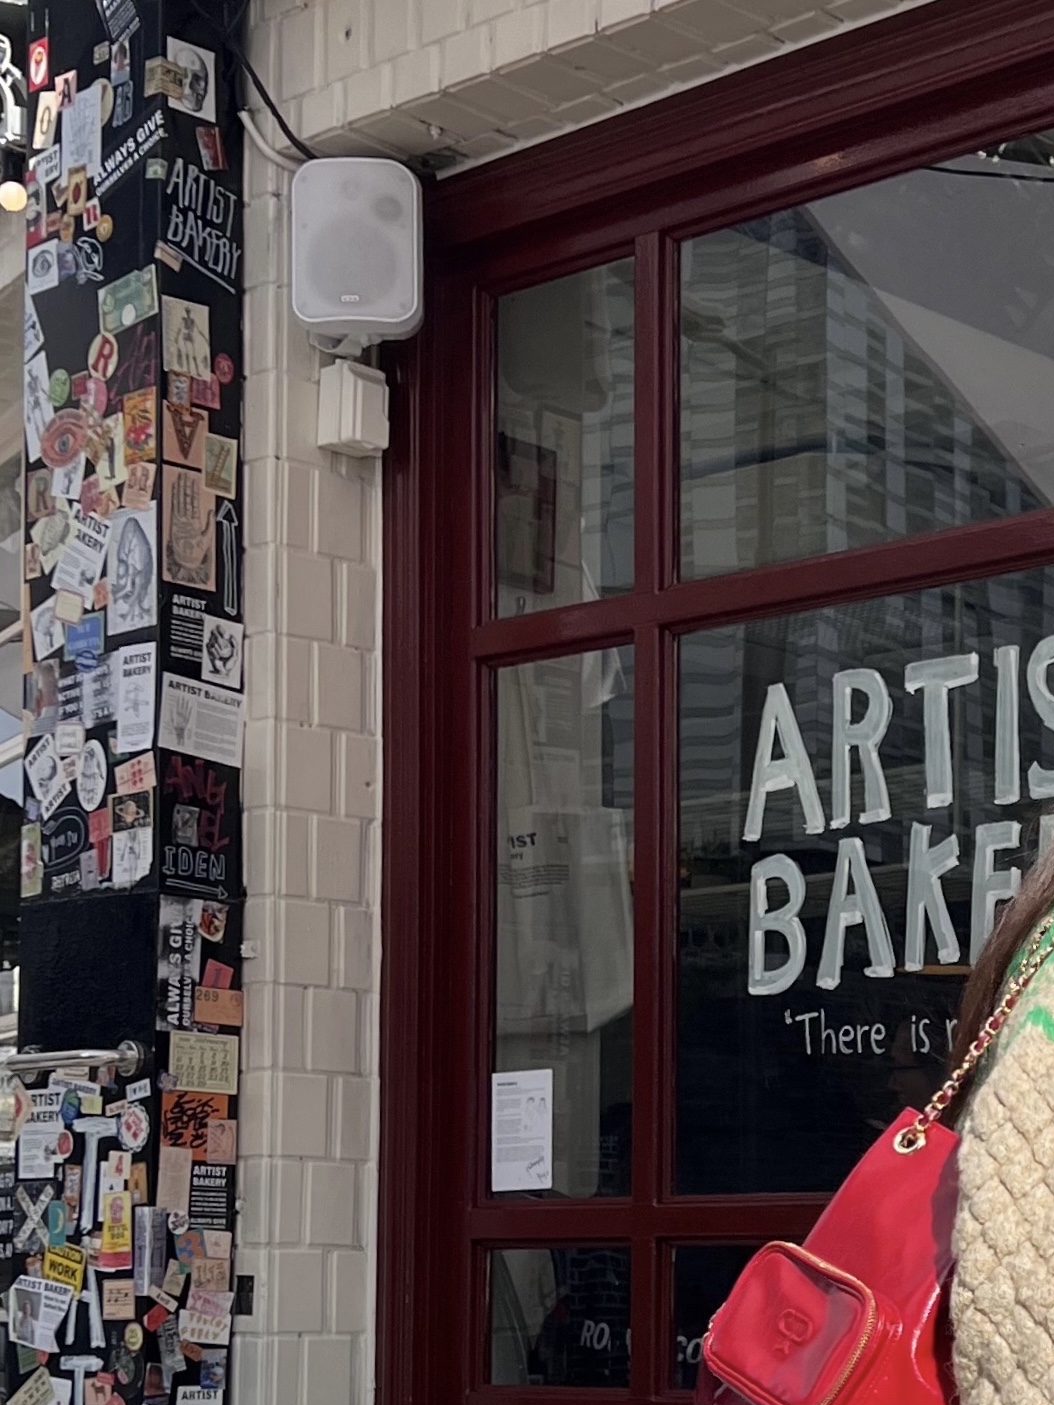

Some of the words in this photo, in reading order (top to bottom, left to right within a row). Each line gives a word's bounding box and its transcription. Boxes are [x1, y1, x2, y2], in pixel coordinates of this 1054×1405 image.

[136, 109, 165, 143] GIVE
[166, 157, 237, 238] ARTIST
[167, 204, 242, 280] BAKERY
[172, 594, 207, 611] ARTIST
[122, 653, 153, 666] ARTIST
[122, 665, 153, 679] BAKERY
[168, 680, 202, 699] ARTIST
[27, 738, 52, 770] ARTIST
[43, 782, 69, 816] ARTIST
[162, 845, 226, 882] IDEN
[911, 1015, 931, 1054] is
[192, 1165, 227, 1177] ARTIST
[192, 1177, 227, 1188] BAKERY
[49, 1259, 78, 1282] WORK
[181, 1389, 218, 1401] ARTIST
